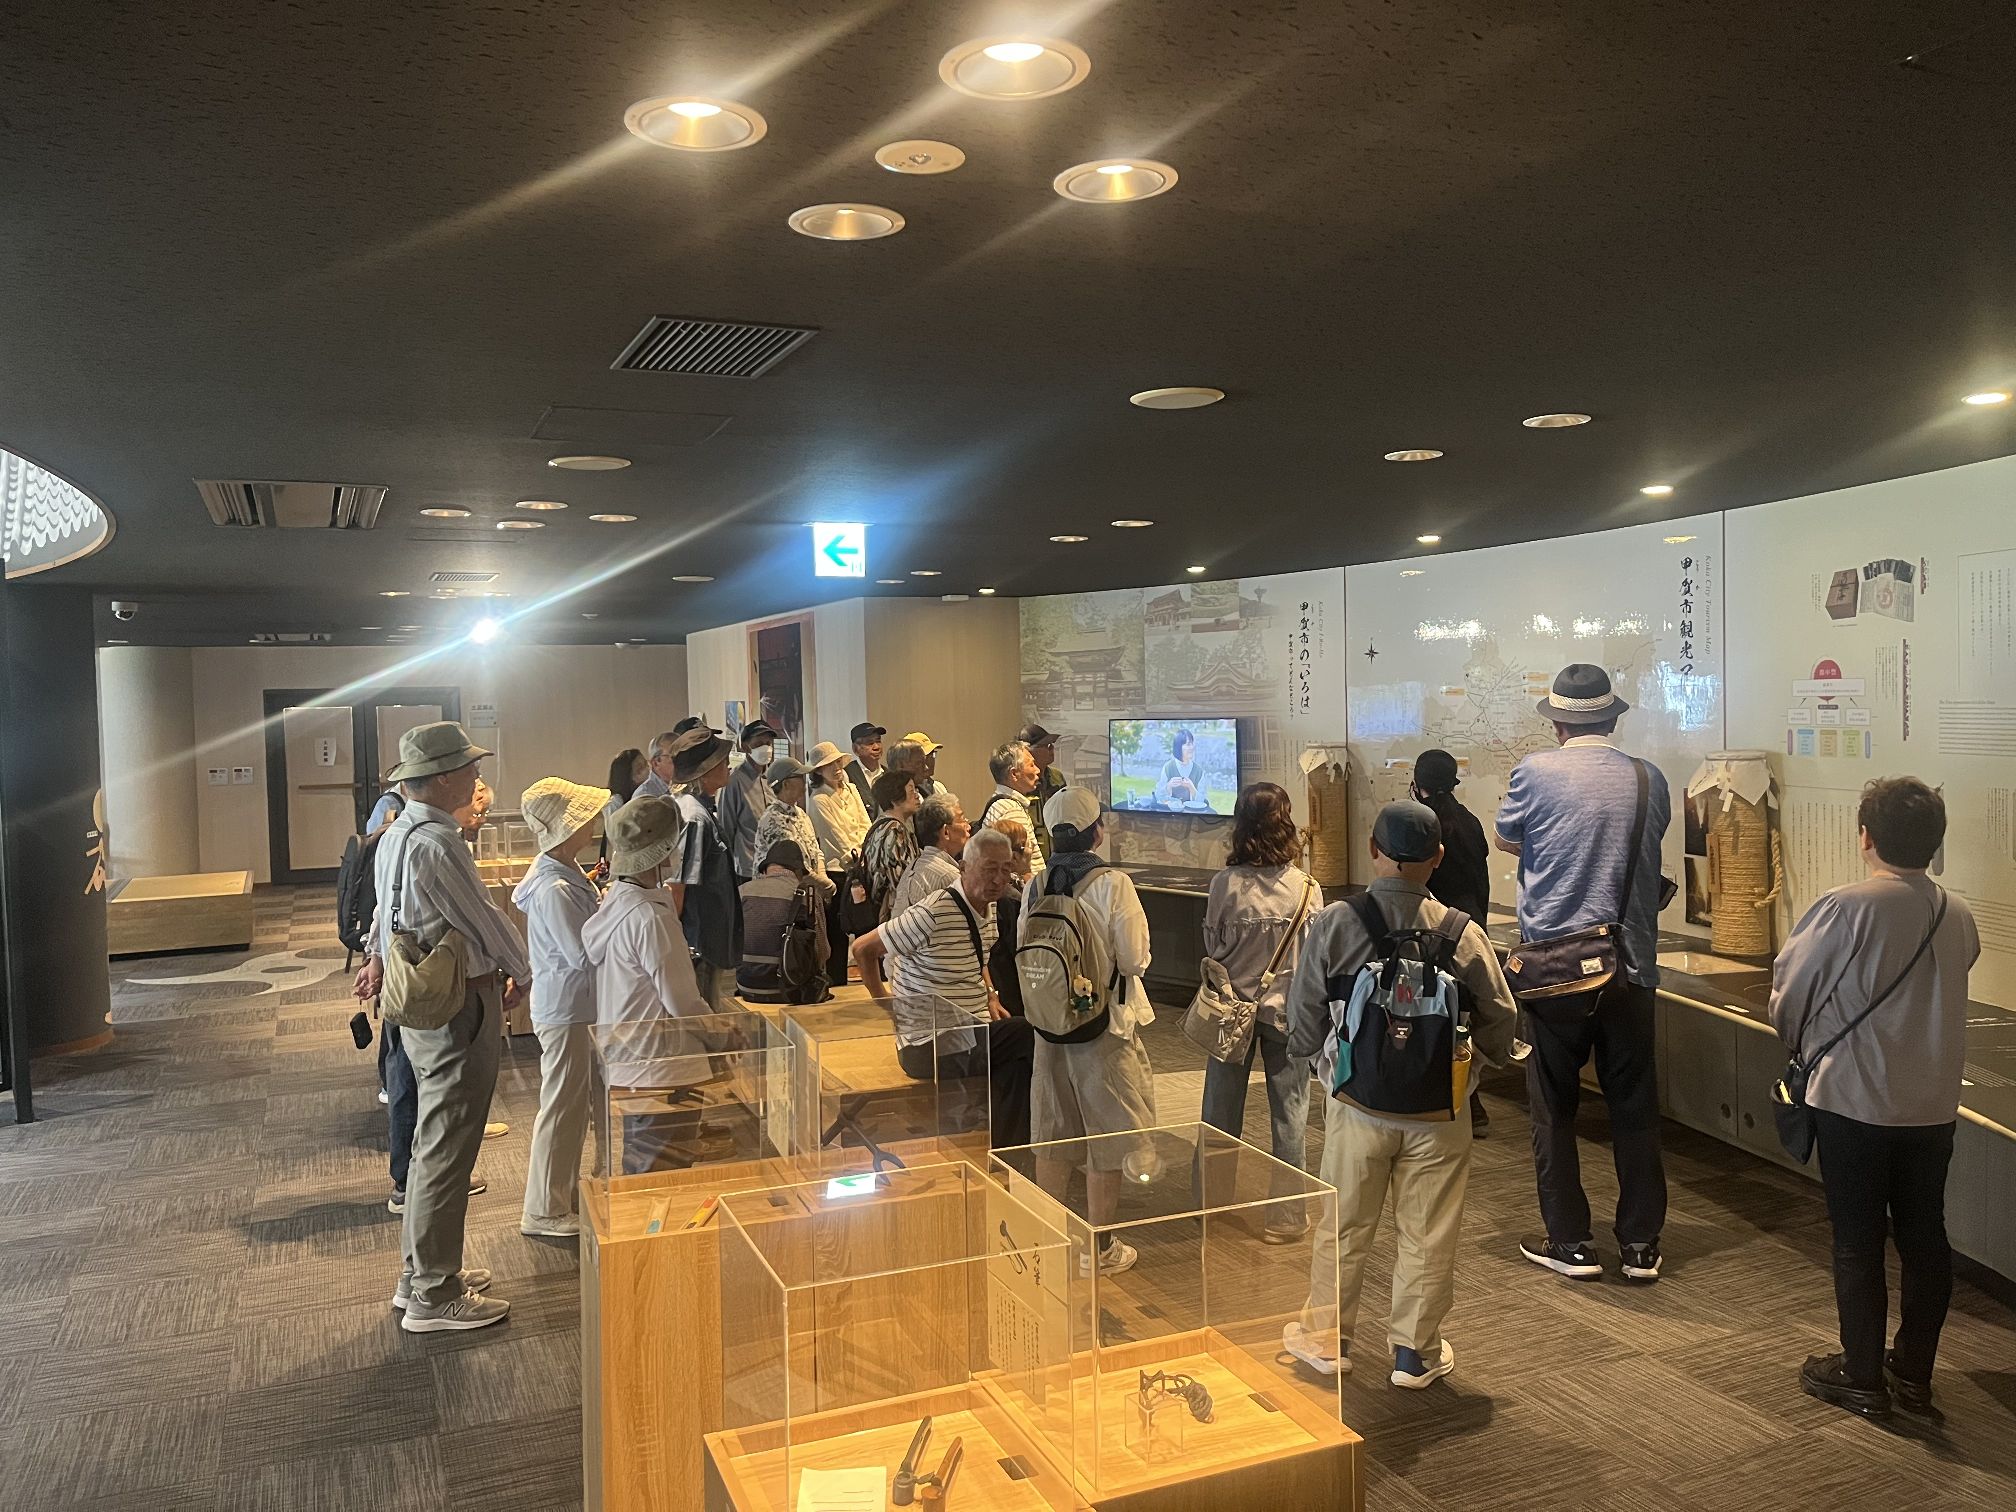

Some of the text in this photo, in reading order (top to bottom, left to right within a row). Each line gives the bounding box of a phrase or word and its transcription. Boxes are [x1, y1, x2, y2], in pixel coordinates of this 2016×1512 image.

[1704, 579, 1712, 597] City
[1680, 556, 1694, 676] 甲賀市観光マ
[1704, 599, 1712, 633] Tourism
[1704, 636, 1712, 655] Map
